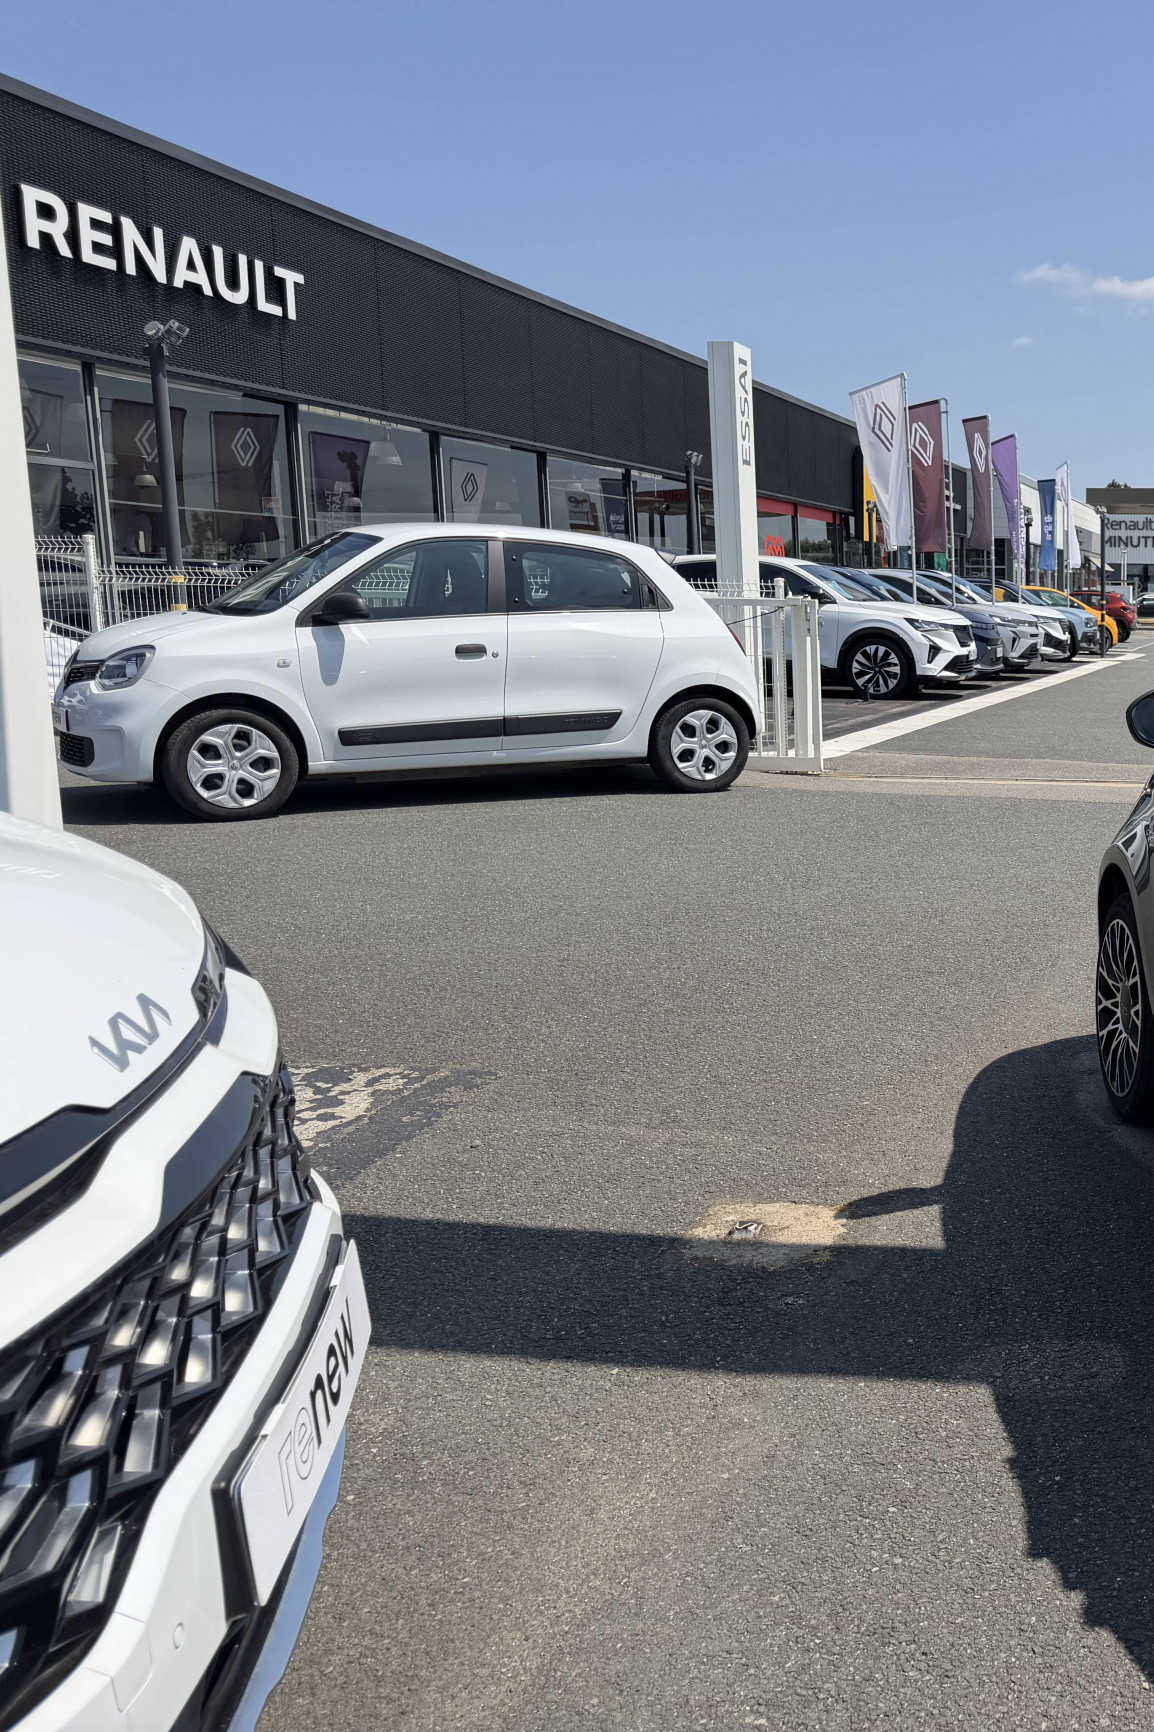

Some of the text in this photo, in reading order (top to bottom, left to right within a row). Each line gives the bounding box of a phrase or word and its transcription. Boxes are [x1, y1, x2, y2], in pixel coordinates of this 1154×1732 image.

[20, 183, 305, 321] RENAULT
[738, 357, 751, 467] ESSAI
[277, 1296, 355, 1517] renew
